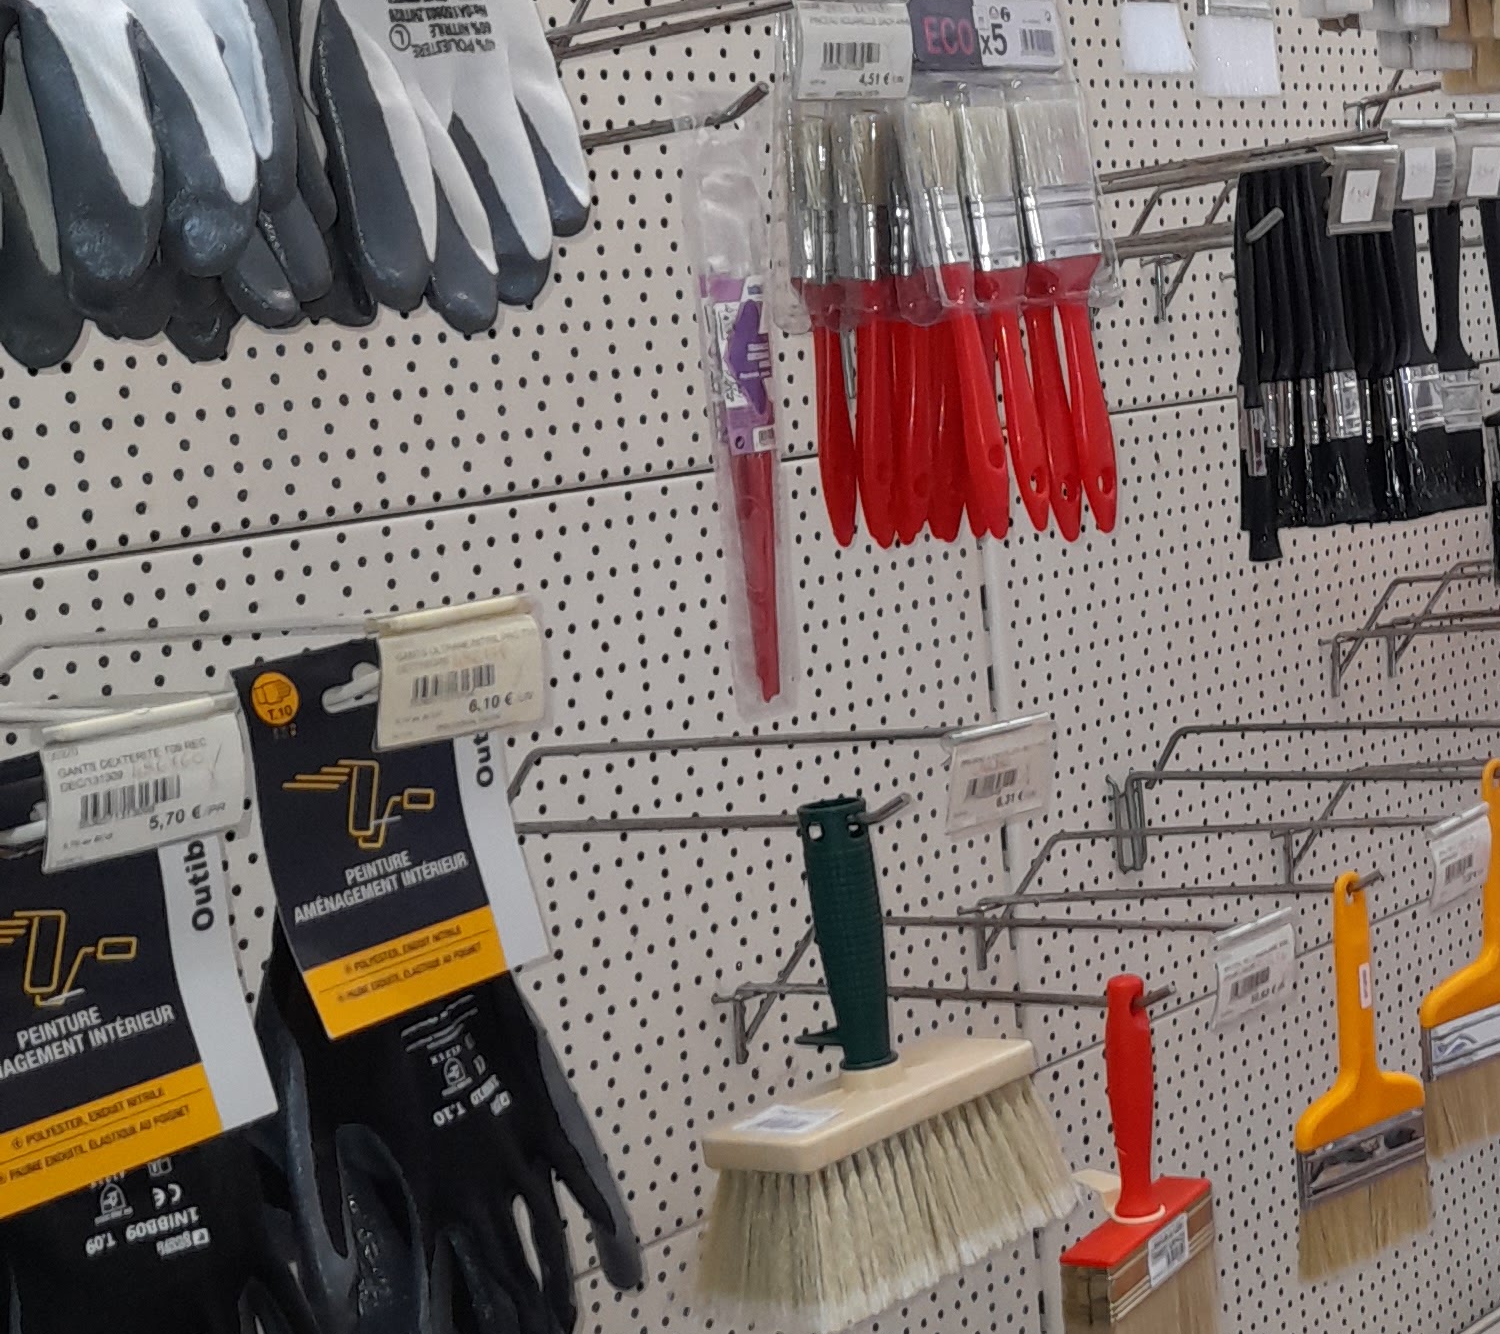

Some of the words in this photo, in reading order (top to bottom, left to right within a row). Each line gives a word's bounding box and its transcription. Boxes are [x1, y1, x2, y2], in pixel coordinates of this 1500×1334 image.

[922, 15, 974, 56] ECO
[149, 808, 186, 831] 5,70
[183, 840, 215, 932] Outib
[293, 875, 399, 925] AMÉNAGEMENT
[400, 850, 469, 888] INTÉRIEUR
[344, 850, 412, 887] PEINTURE
[0, 1033, 85, 1080] AGEMENT
[88, 1004, 176, 1049] INTÉRIEUR
[16, 1006, 102, 1050] PEINTURE
[85, 1232, 117, 1257] T.09
